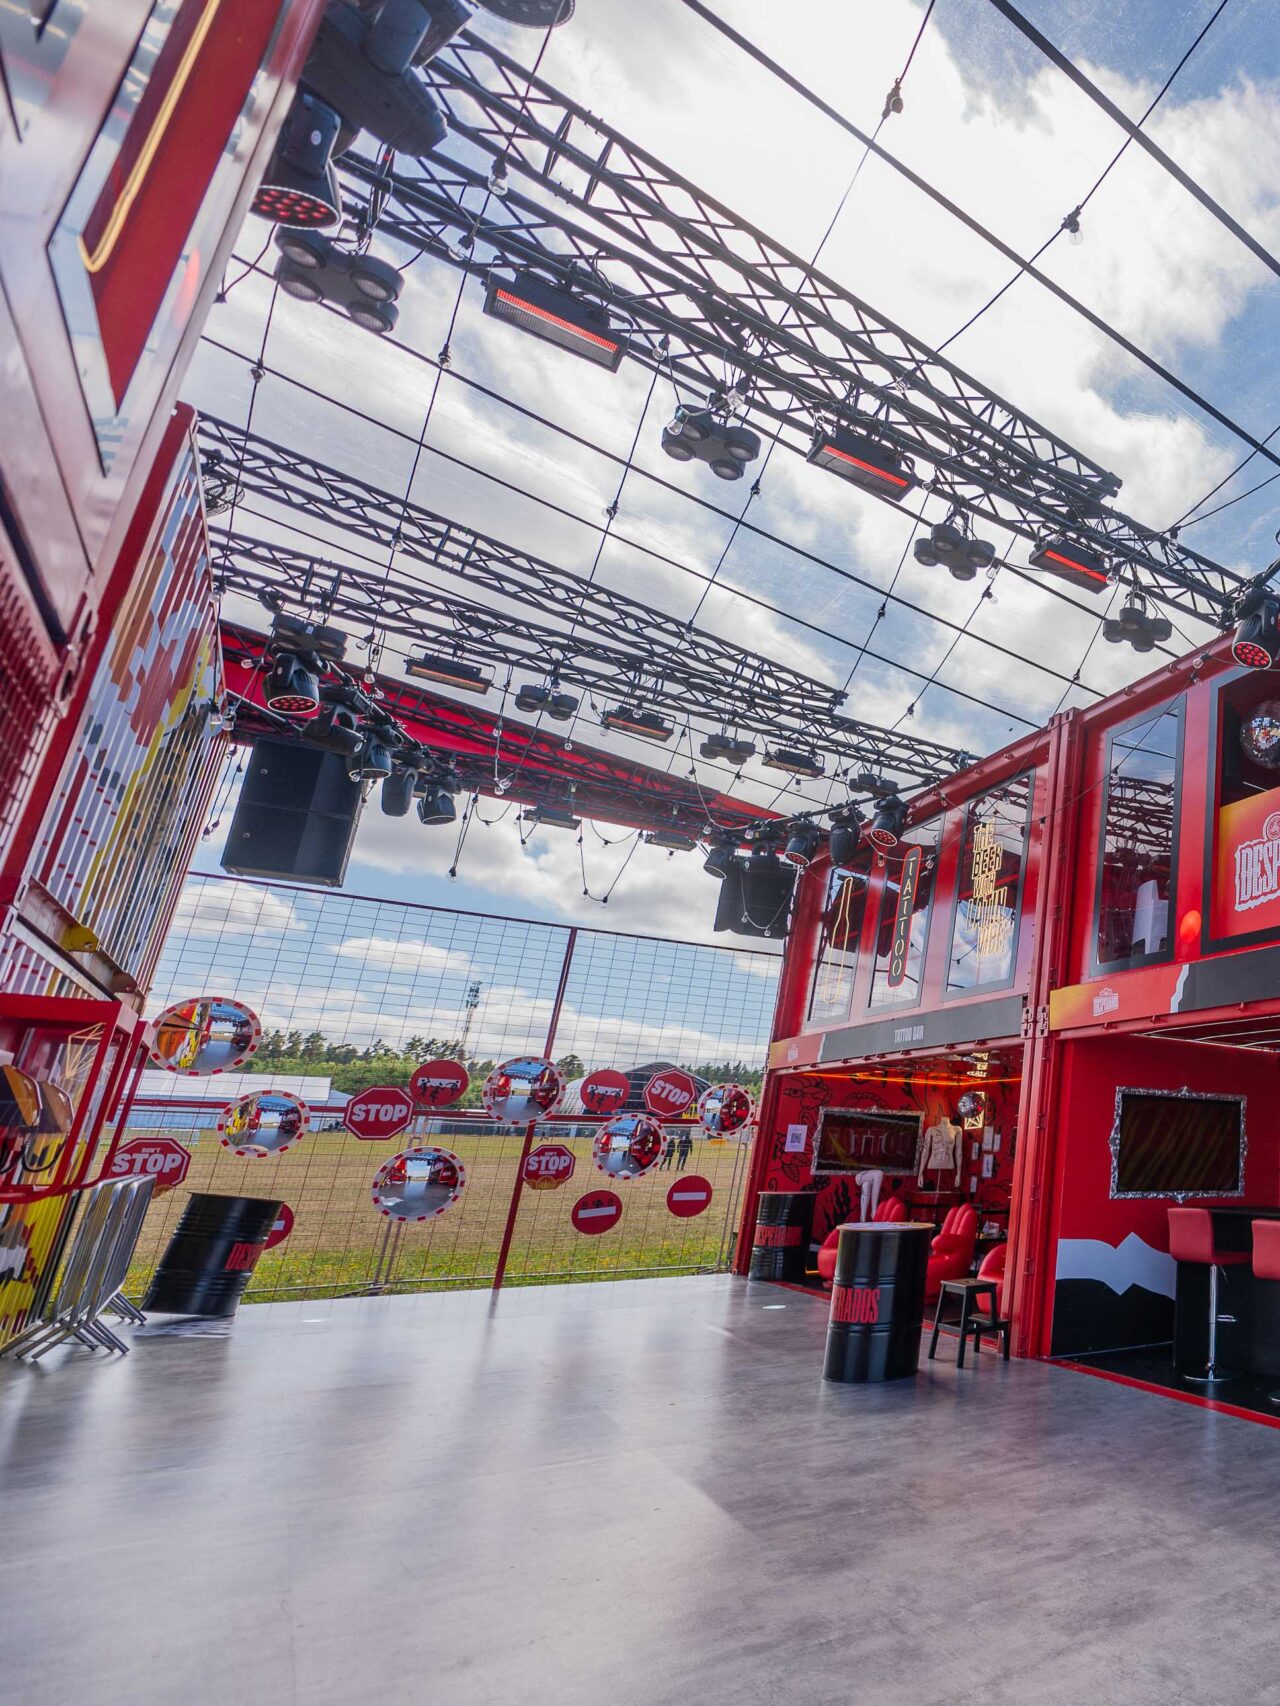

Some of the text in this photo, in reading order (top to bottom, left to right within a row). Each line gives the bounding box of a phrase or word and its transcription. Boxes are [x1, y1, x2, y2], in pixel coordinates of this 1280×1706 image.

[971, 841, 1004, 880] BEER
[892, 857, 917, 977] TATTOO
[912, 1024, 925, 1041] BAR
[650, 1080, 691, 1106] STOP
[351, 1104, 408, 1122] STOP
[111, 1153, 182, 1174] STOP
[528, 1155, 571, 1171] STOP
